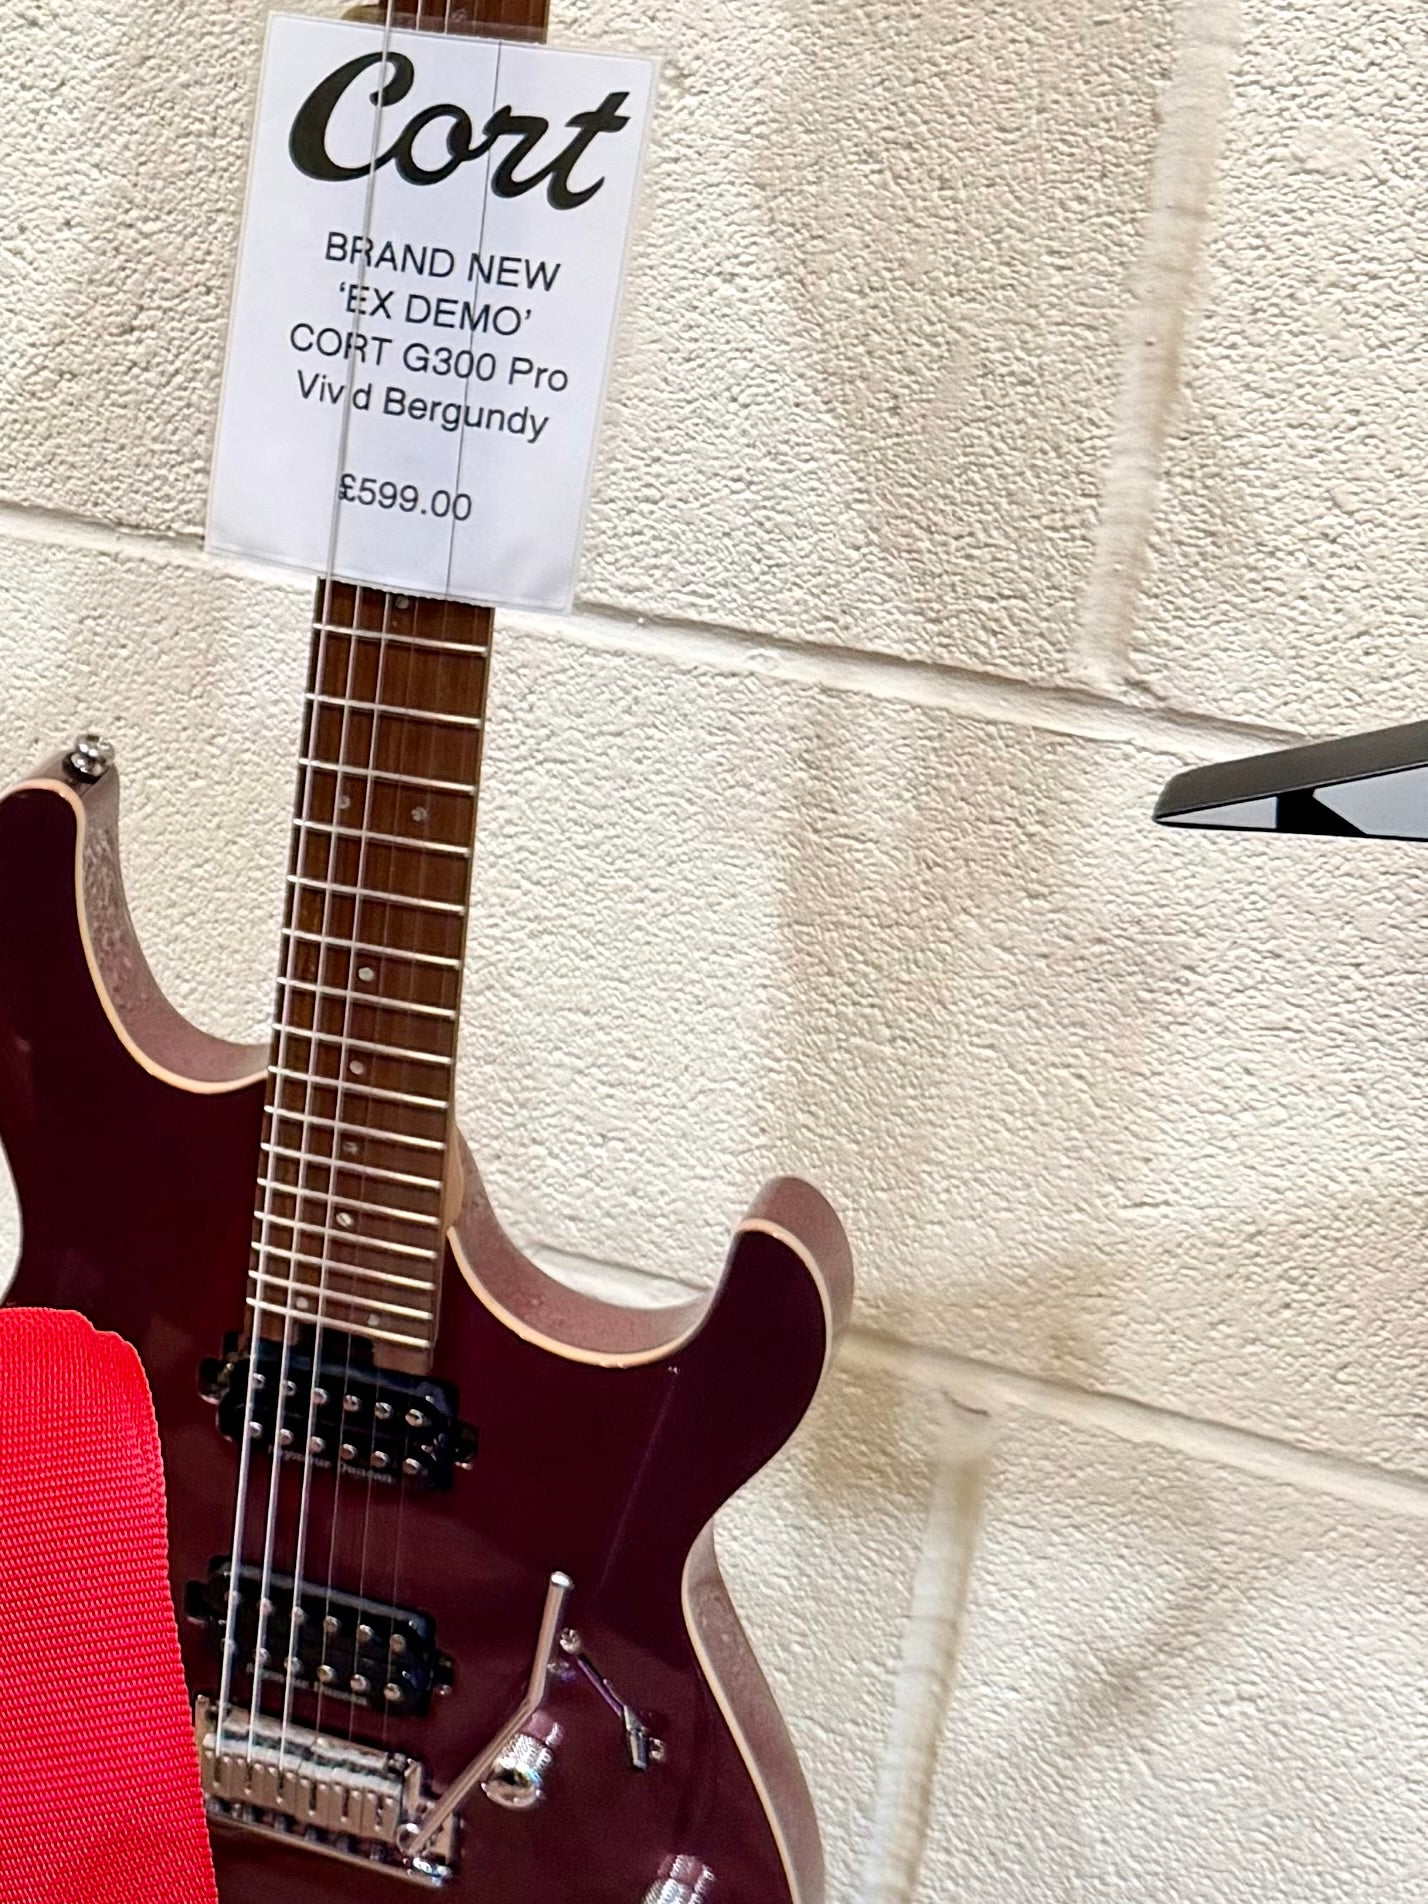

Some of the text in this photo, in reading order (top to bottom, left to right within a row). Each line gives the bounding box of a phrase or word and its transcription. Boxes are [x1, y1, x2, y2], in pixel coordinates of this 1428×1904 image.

[288, 51, 631, 210] Cort
[325, 231, 561, 292] BRAND NEW
[290, 322, 569, 392] CORT G300 Pro
[297, 369, 549, 444] Vivd Bergundy
[338, 473, 472, 521] £599.00
